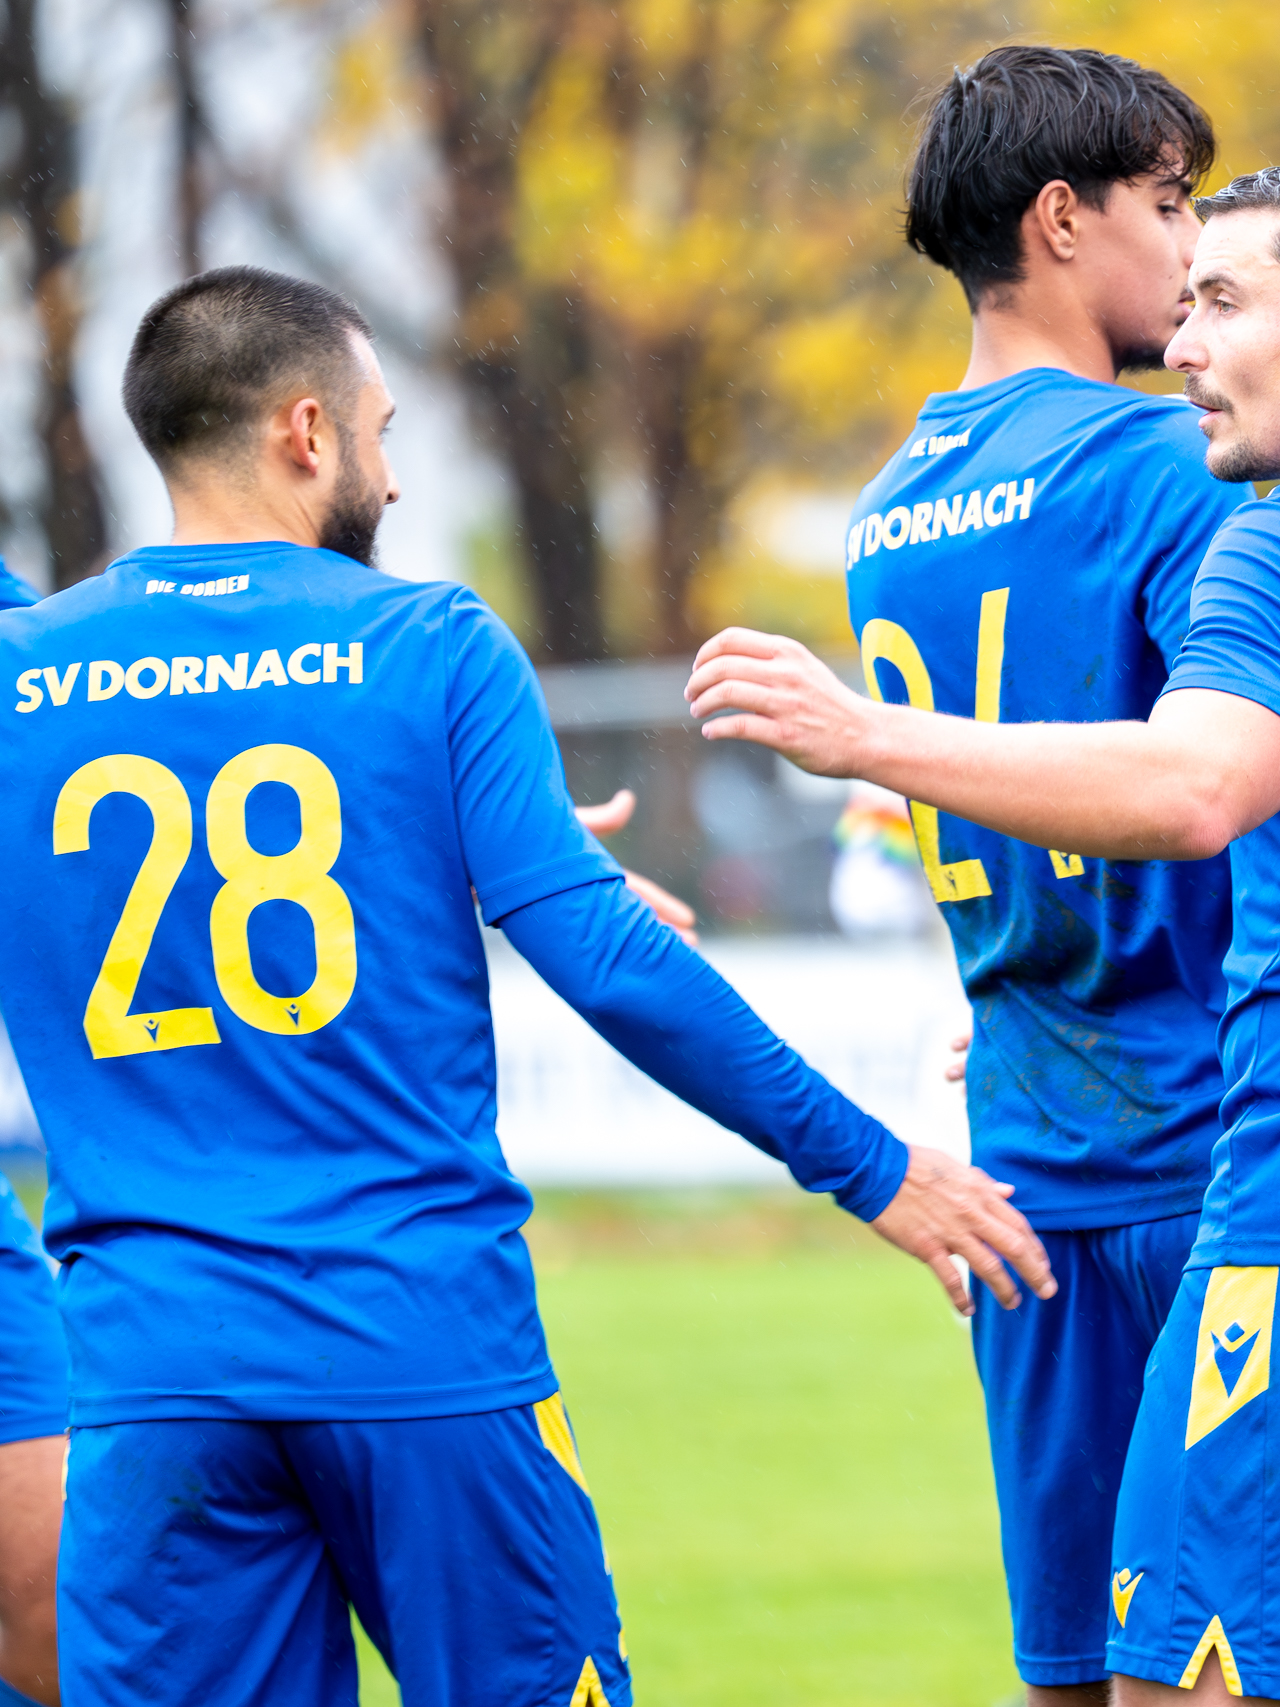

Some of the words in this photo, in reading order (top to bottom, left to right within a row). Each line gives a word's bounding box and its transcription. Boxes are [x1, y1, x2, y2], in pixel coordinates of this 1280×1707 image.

[864, 478, 1034, 557] DORNACH
[15, 662, 82, 713] SV
[88, 642, 363, 702] DORNACH
[53, 743, 357, 1060] 28
